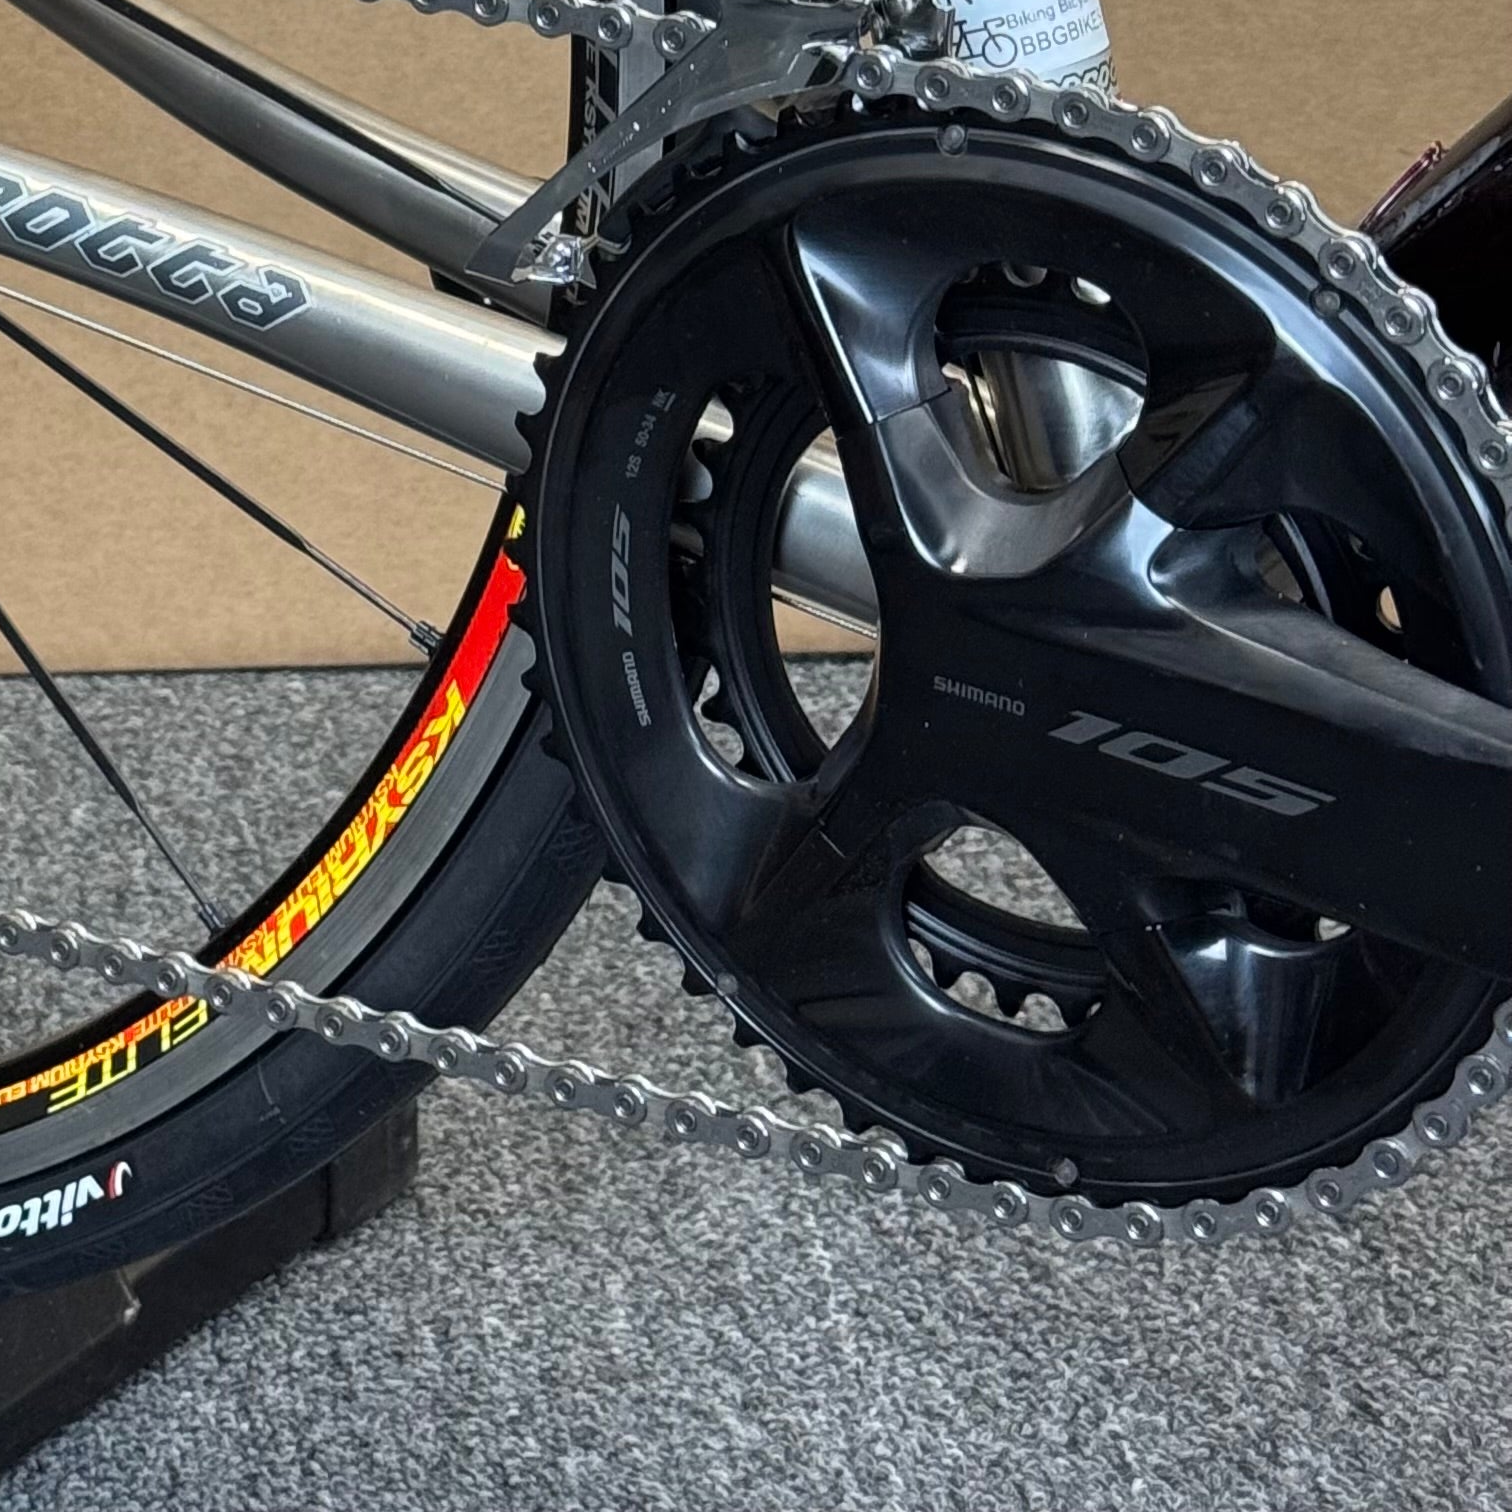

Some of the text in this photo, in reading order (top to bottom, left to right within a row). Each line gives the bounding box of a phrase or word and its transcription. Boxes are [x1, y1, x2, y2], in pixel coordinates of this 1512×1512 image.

[611, 503, 633, 637] 105
[622, 651, 651, 727] SHIMANO
[934, 675, 1025, 716] SHIMANO
[1048, 710, 1337, 816] 105
